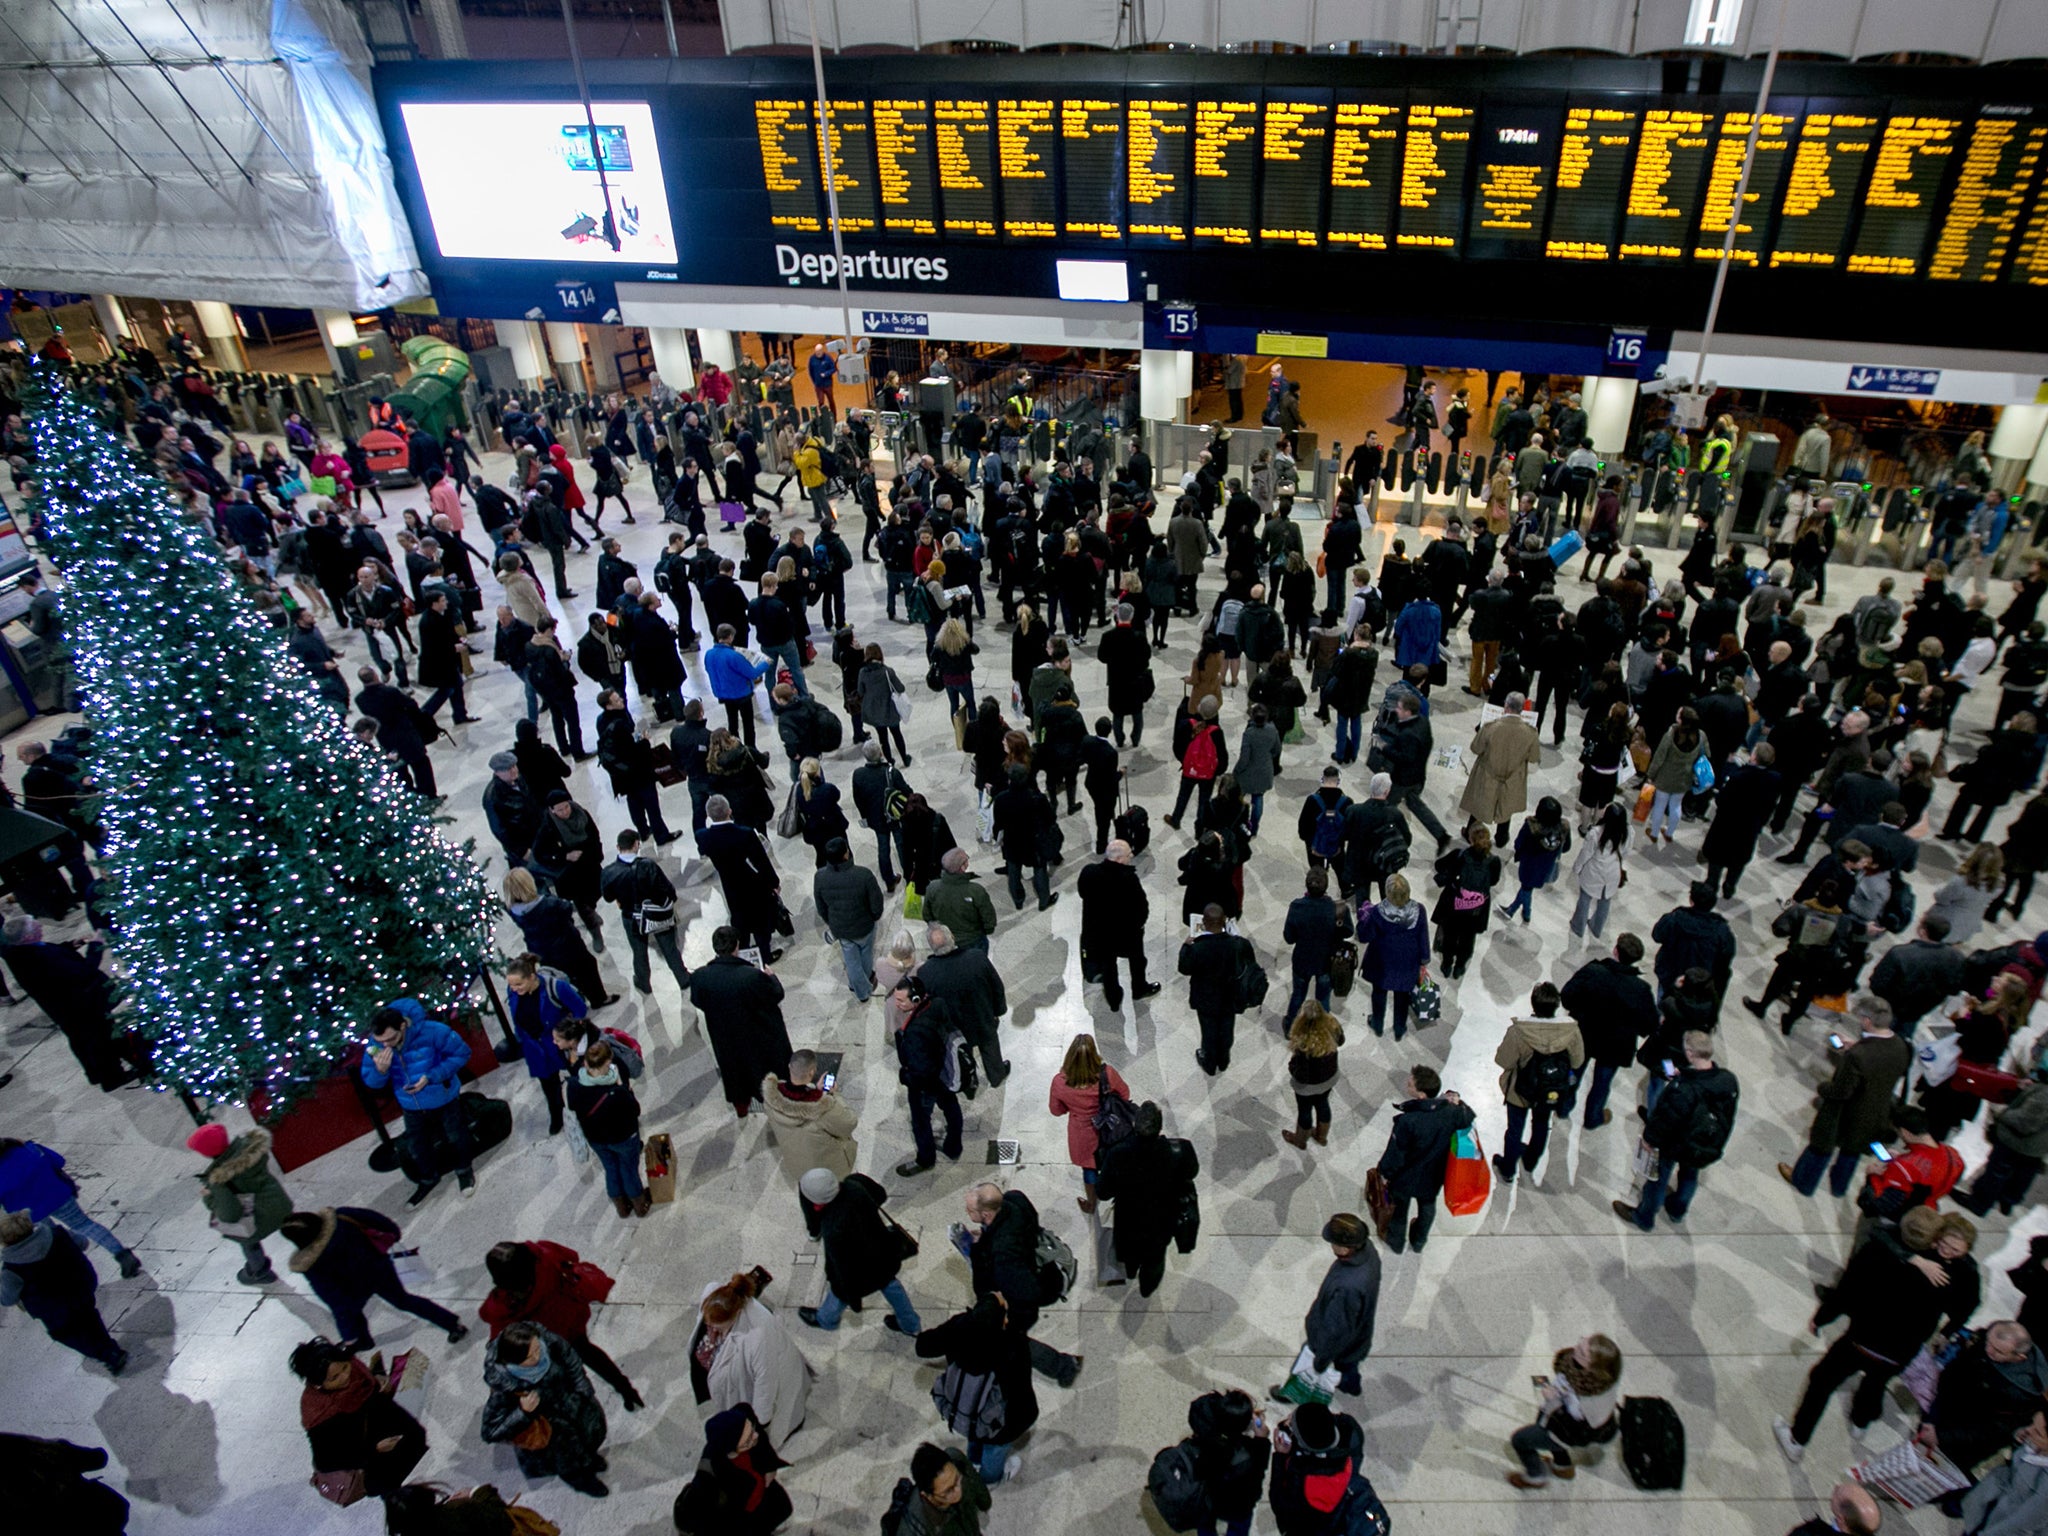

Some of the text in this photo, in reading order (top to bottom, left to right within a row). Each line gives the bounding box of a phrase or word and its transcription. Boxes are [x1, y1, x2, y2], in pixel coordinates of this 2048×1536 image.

[775, 244, 949, 284] Departures
[559, 289, 579, 308] 14
[580, 287, 596, 307] 14
[1167, 313, 1189, 333] 15
[1616, 338, 1642, 361] 16
